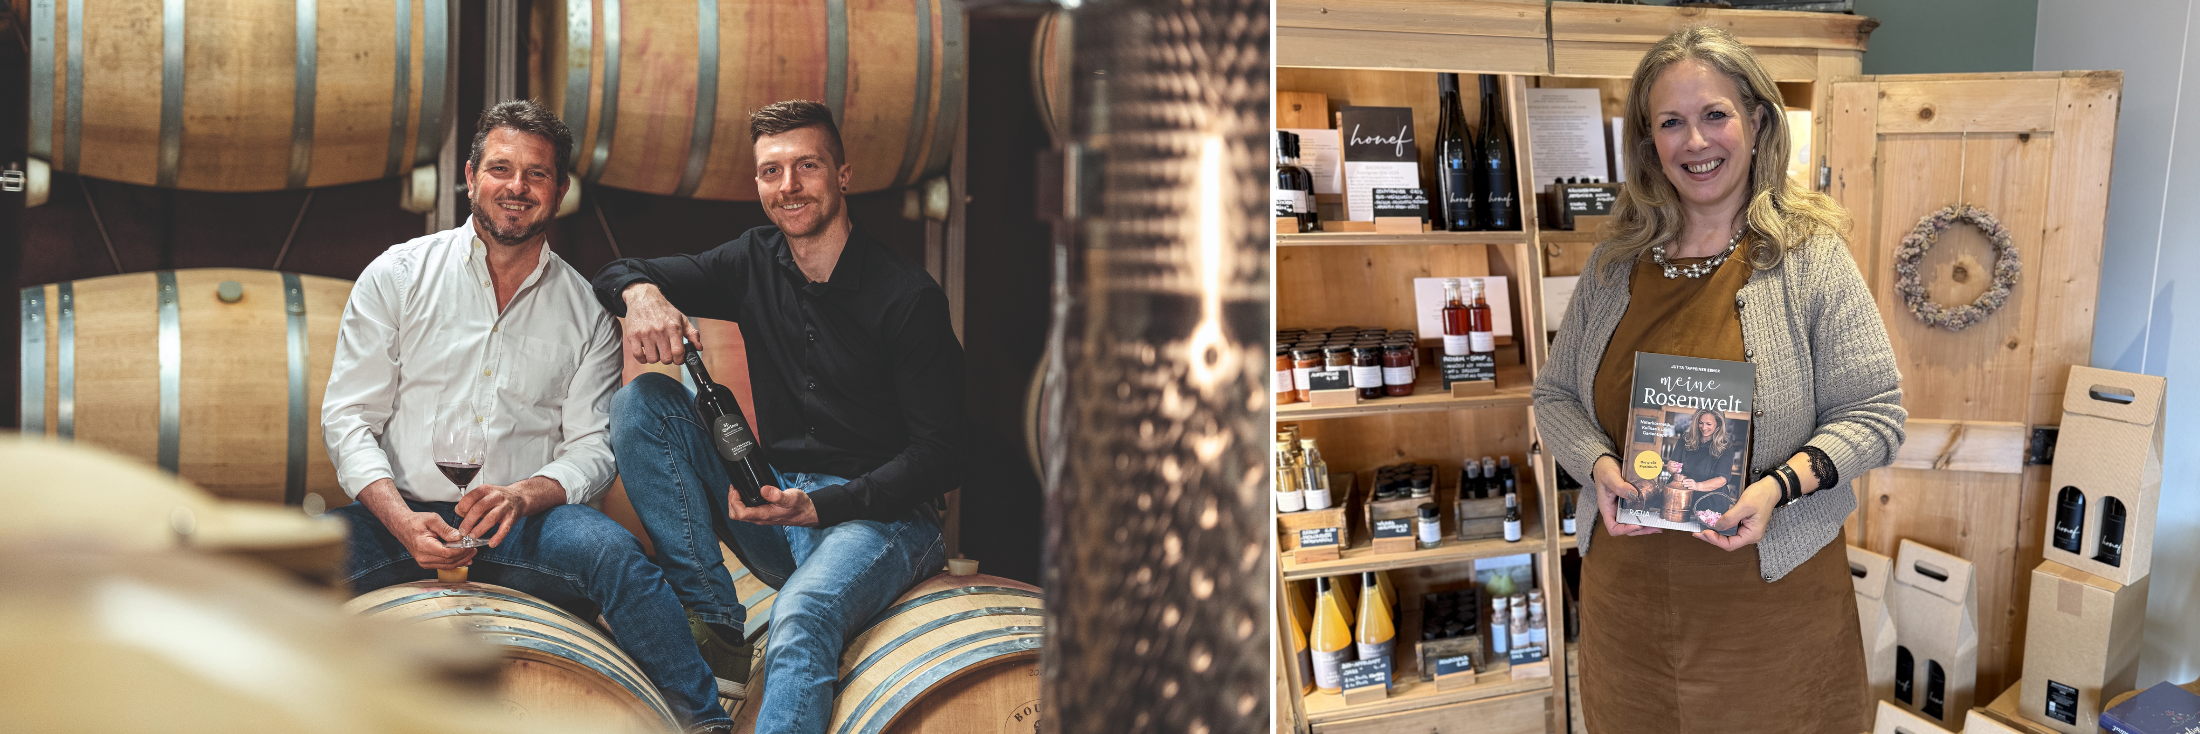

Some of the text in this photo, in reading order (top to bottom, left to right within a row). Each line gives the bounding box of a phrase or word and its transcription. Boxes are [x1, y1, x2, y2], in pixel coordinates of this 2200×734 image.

[1350, 123, 1413, 157] honef
[1450, 192, 1475, 208] honef
[1488, 191, 1513, 207] honef
[1660, 376, 1721, 392] meine
[1643, 387, 1742, 413] Rosenwelt
[2056, 520, 2081, 539] honef
